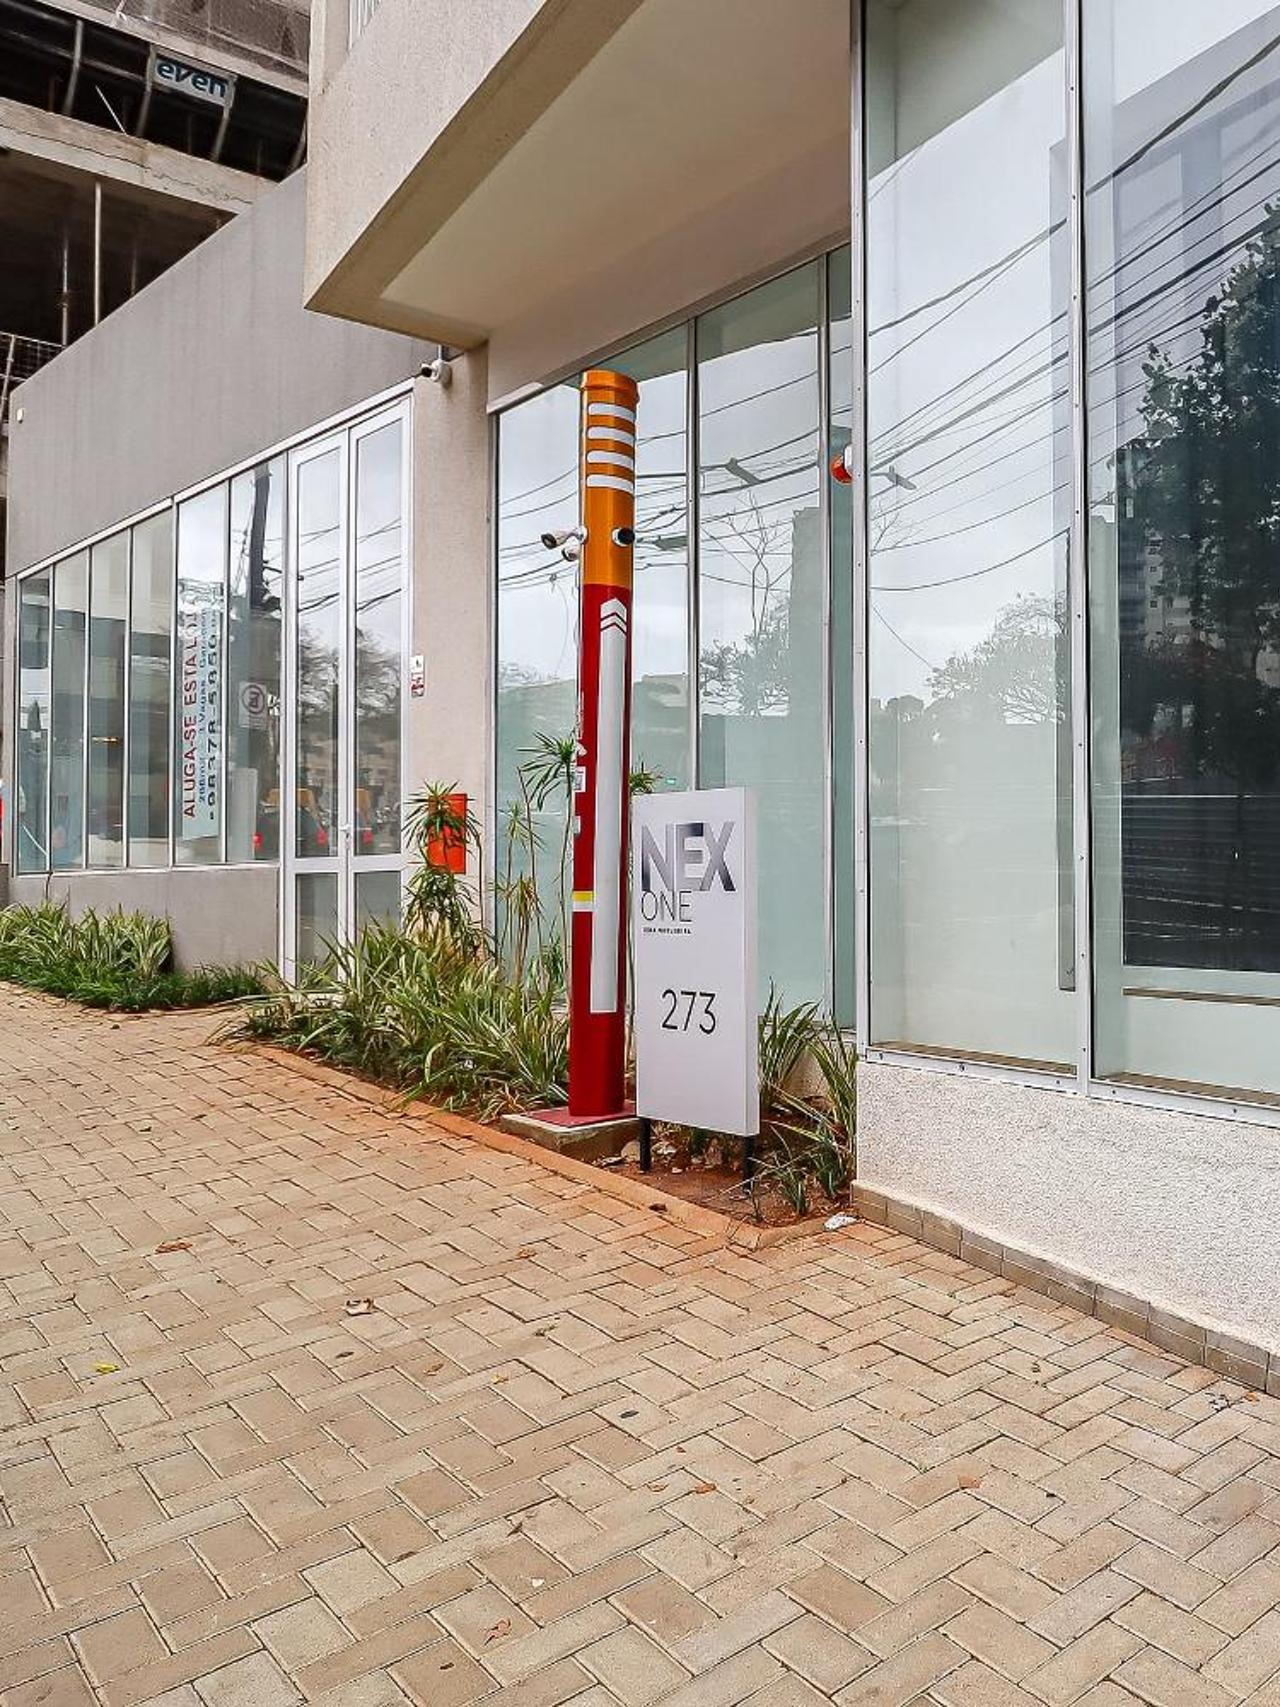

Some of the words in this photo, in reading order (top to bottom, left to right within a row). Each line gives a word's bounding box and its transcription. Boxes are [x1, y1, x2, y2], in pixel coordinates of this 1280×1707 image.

[157, 62, 226, 98] even
[185, 600, 197, 650] LOJ
[184, 654, 197, 706] ESTA
[184, 716, 196, 818] ALUGA-SE
[641, 822, 736, 892] NEX
[641, 891, 692, 922] ONE
[662, 989, 716, 1034] 273
